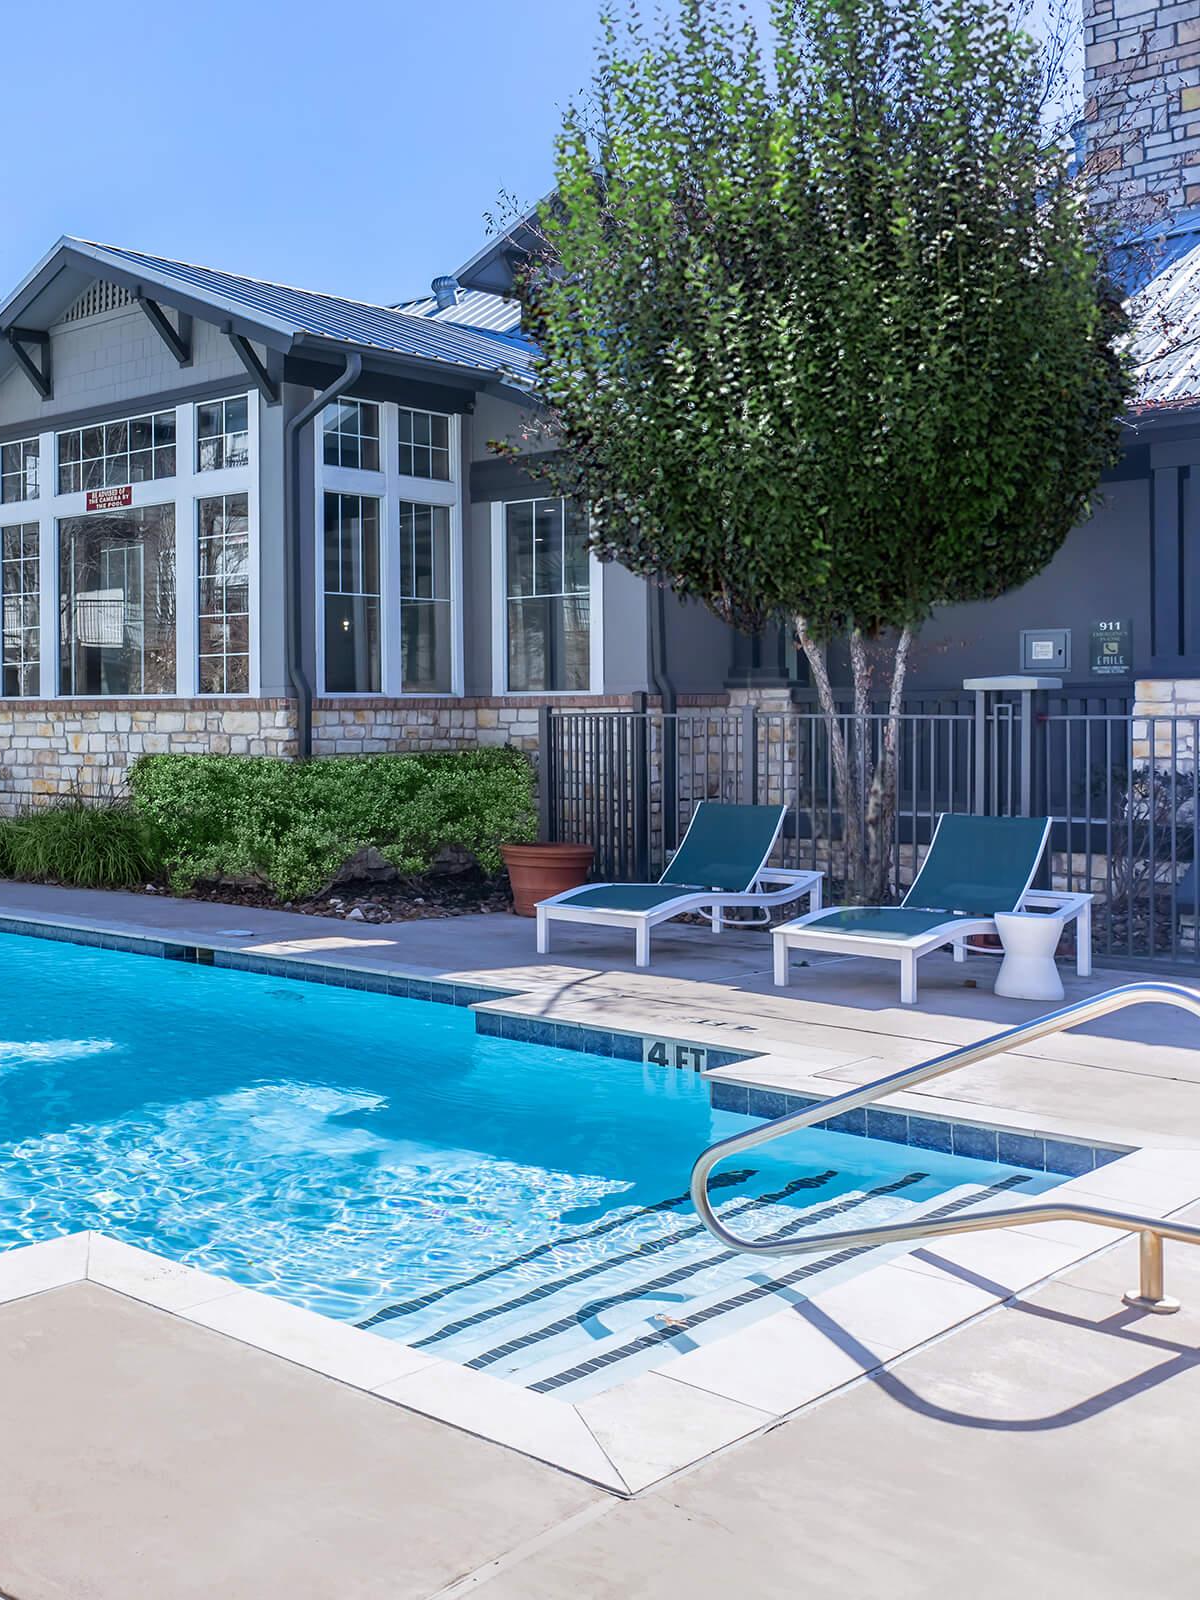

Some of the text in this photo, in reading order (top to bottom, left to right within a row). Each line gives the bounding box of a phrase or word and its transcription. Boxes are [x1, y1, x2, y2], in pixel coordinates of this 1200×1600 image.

[99, 494, 121, 503] CAMERA
[1099, 621, 1120, 631] 911
[647, 1041, 705, 1073] 4 FT
